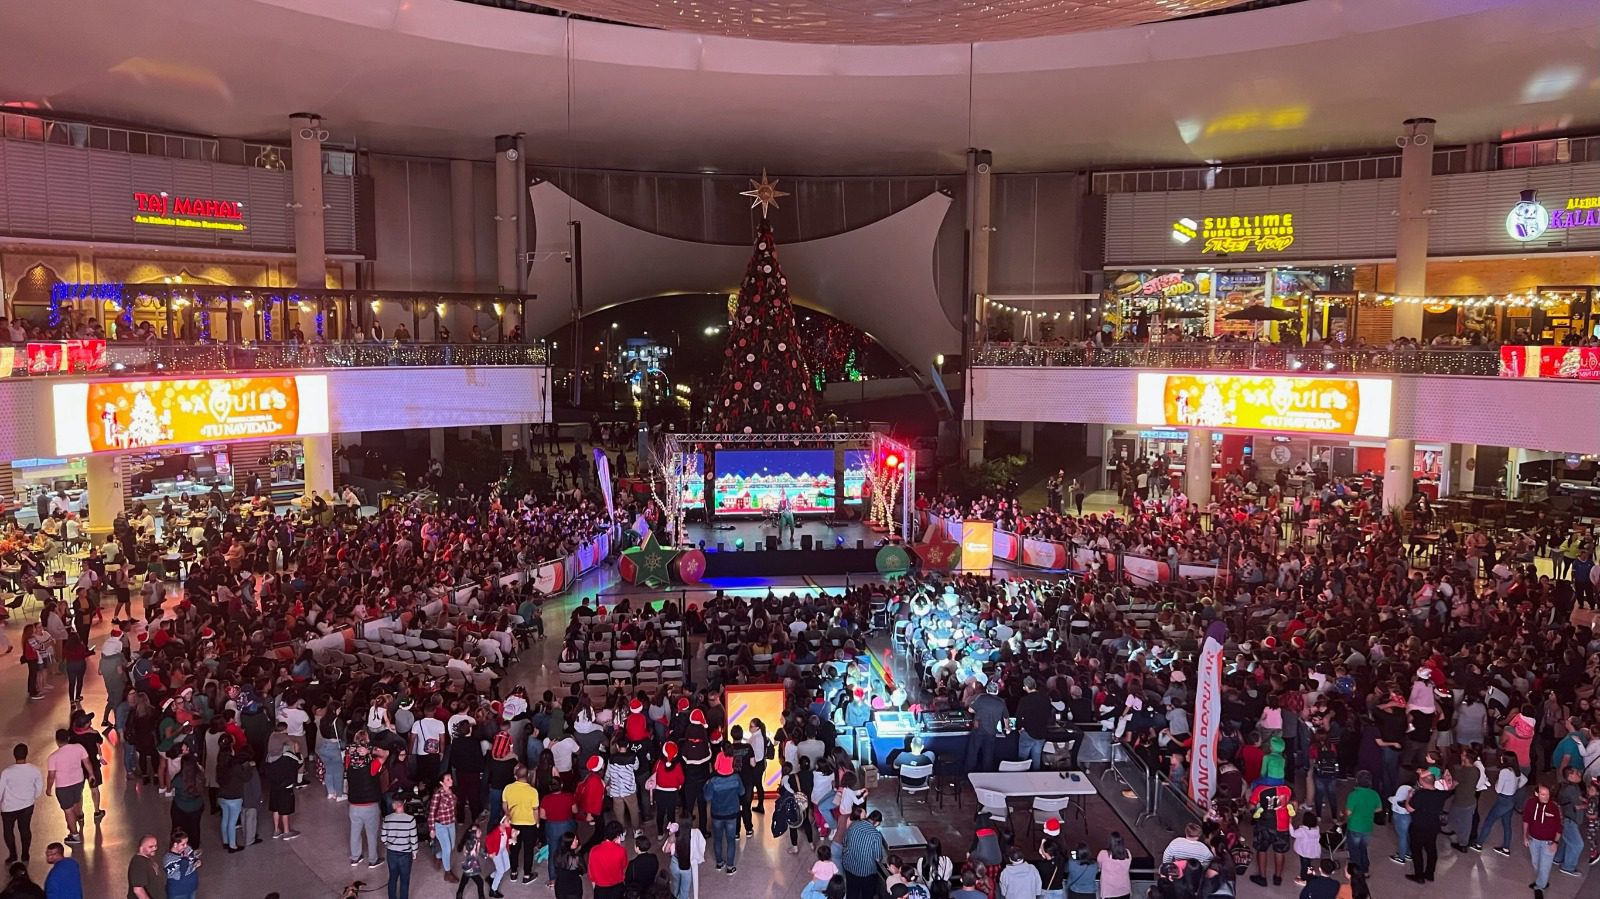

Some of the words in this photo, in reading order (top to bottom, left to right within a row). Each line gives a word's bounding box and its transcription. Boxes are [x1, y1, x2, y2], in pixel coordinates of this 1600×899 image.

[134, 192, 168, 217] TAJ
[173, 197, 243, 219] MAHAL
[1202, 228, 1252, 238] BURGERS
[1264, 226, 1294, 235] SUBS
[1204, 214, 1293, 230] SUBLIME
[223, 421, 276, 435] NAVIDAD
[1199, 651, 1216, 738] POPULAR
[1198, 744, 1209, 811] BANCO
